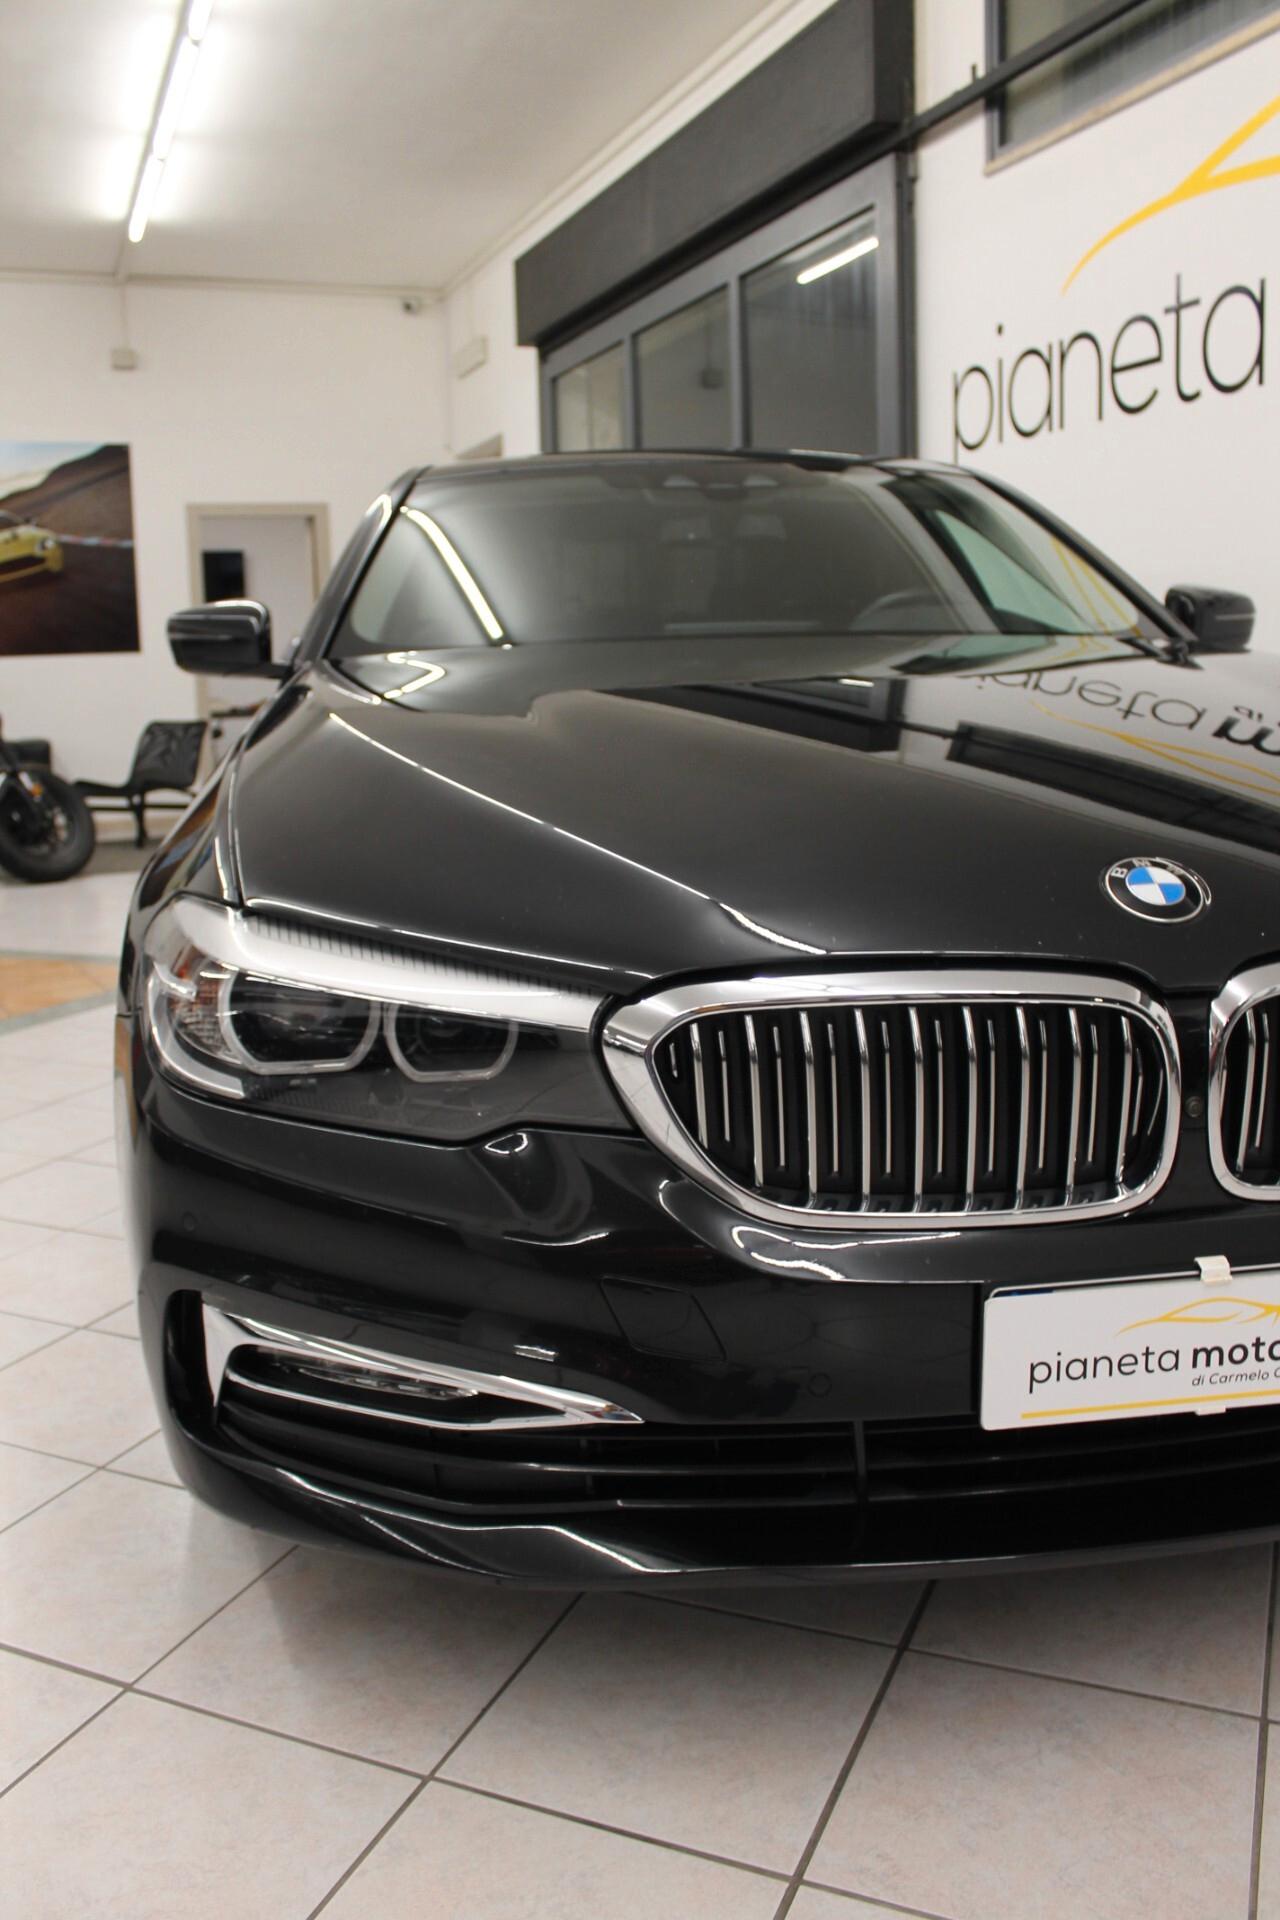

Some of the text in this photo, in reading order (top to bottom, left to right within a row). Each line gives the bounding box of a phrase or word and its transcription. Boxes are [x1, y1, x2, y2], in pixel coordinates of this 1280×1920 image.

[953, 273, 1266, 466] pianeta
[1111, 858, 1186, 878] BMW
[1029, 1346, 1180, 1394] pianeta
[1191, 1374, 1205, 1386] di
[1209, 1369, 1269, 1385] Carmelo
